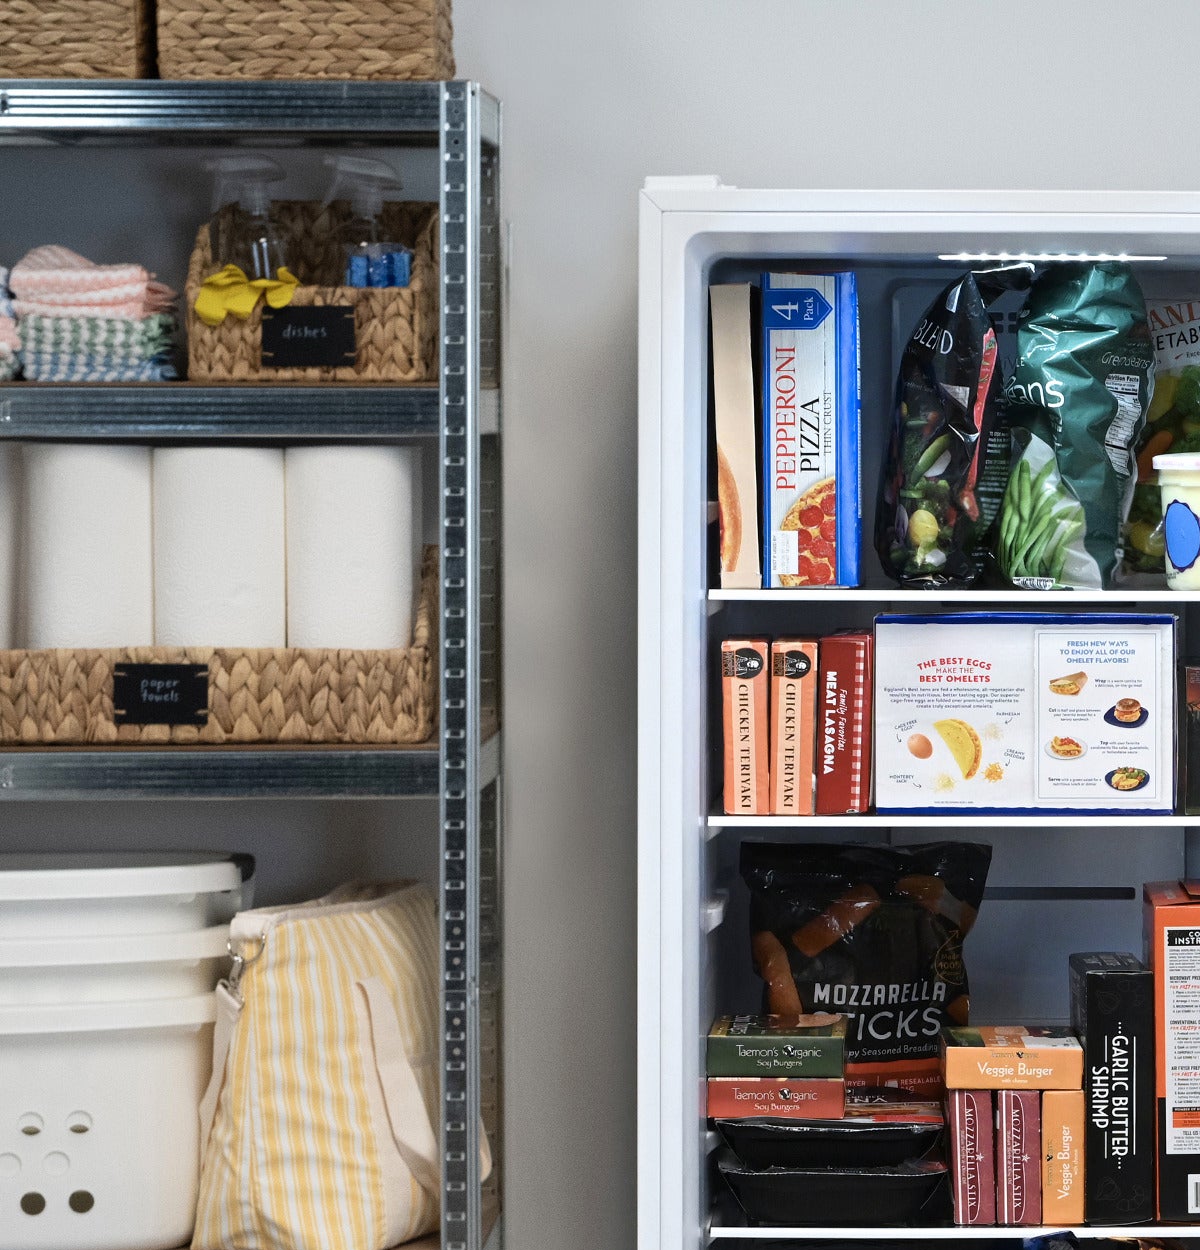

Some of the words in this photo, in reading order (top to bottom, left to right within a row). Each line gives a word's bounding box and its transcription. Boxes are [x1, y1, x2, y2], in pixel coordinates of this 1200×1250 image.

[771, 301, 799, 321] 4
[803, 296, 814, 322] Pack
[282, 323, 328, 338] dishes
[914, 318, 954, 355] BLEND
[776, 347, 796, 490] PEPPERONI
[824, 390, 832, 425] CRUST
[800, 397, 820, 473] PIZZA
[824, 427, 832, 455] THIN
[917, 659, 937, 671] THE
[939, 657, 964, 666] BEST
[966, 658, 992, 671] EGGS
[141, 680, 179, 693] paper
[826, 671, 838, 706] MEAT
[919, 675, 943, 683] BEST
[945, 675, 991, 683] OMELETS
[141, 689, 180, 702] towels
[838, 689, 848, 714] Family
[738, 684, 750, 742] CHICKEN
[785, 683, 796, 742] CHICKEN
[823, 709, 837, 775] LASAGNA
[837, 716, 847, 752] Favorites
[740, 747, 751, 808] TERIYAKI
[783, 746, 795, 808] TERIYAKI
[814, 979, 946, 1005] MOZZARELLA
[736, 1044, 778, 1057] Taemon's
[862, 1046, 901, 1057] Seasoned
[903, 1043, 938, 1053] Breading
[1112, 1035, 1128, 1092] GARLIC
[757, 1059, 772, 1069] Soy
[773, 1059, 802, 1068] Burgers
[977, 1062, 1014, 1078] Veggie
[1018, 1063, 1053, 1078] Burger
[901, 1076, 941, 1084] RESEALABLE
[732, 1088, 774, 1100] Taemon's
[1092, 1066, 1109, 1129] SHRIMP
[754, 1103, 769, 1113] Soy
[771, 1103, 800, 1112] Burgers
[1112, 1096, 1128, 1156] BUTTER
[1058, 1126, 1072, 1160] Burger
[1057, 1164, 1072, 1199] Veggie
[967, 1184, 977, 1208] STIX
[1013, 1184, 1022, 1208] STIX
